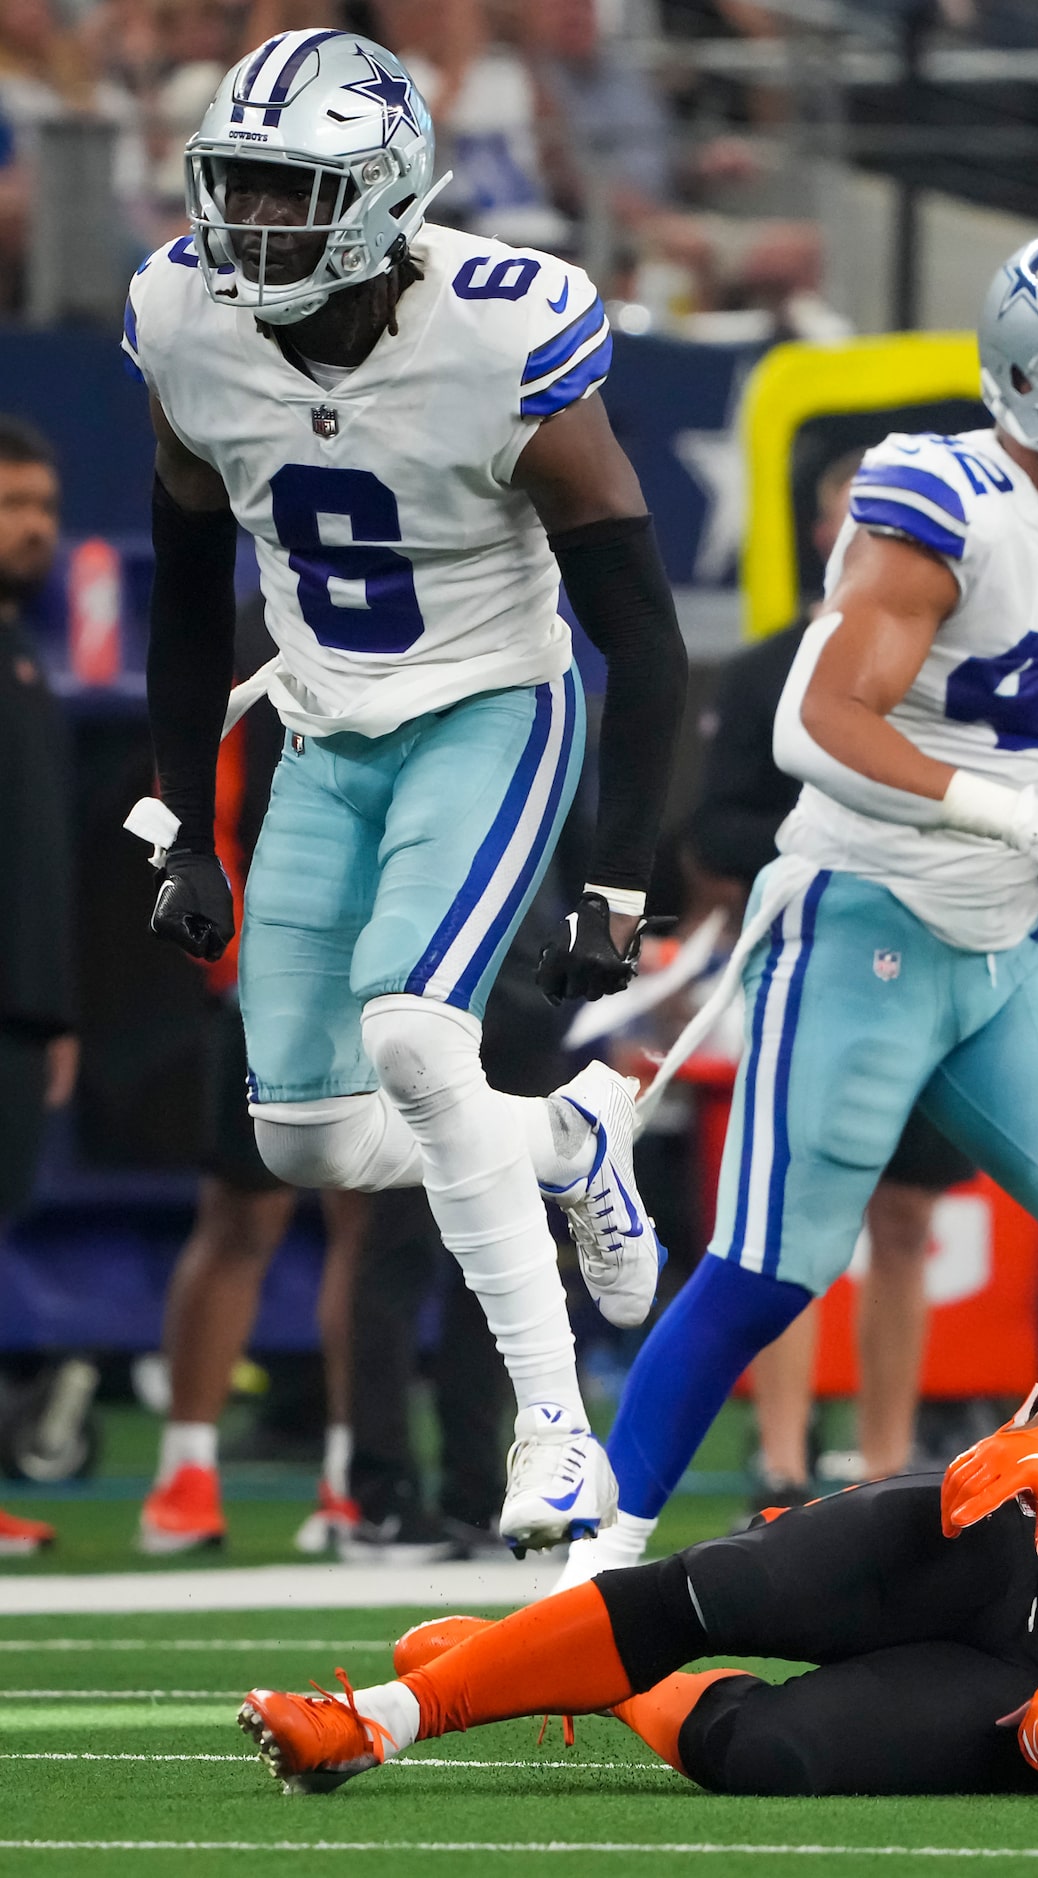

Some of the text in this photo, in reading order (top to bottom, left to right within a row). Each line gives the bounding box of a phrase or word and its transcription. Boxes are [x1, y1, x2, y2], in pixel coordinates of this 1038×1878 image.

[229, 130, 268, 141] COWBOYS
[452, 255, 542, 301] 6
[268, 463, 425, 654] 6
